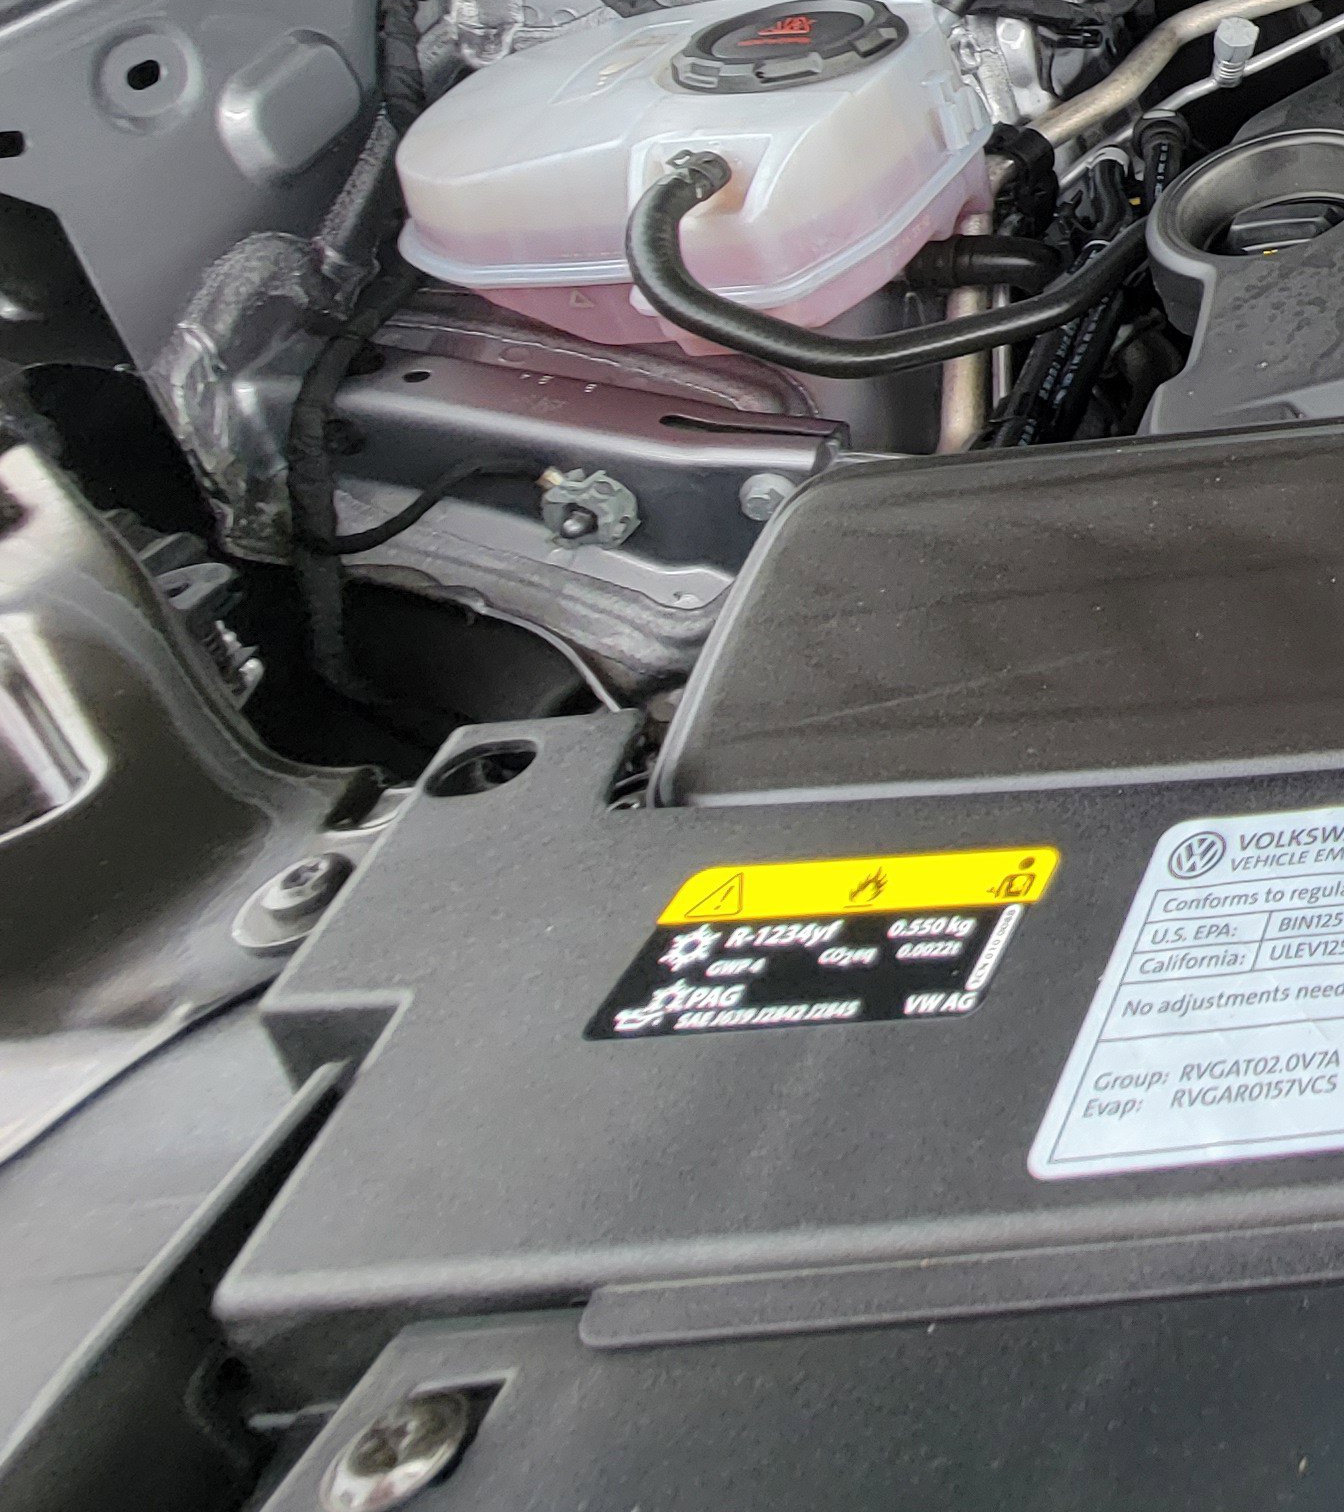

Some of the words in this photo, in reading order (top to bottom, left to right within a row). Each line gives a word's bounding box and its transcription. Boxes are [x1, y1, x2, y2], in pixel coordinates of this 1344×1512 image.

[1230, 850, 1310, 873] VEHICLE
[1163, 892, 1258, 913] Conforms
[1264, 887, 1285, 903] to
[723, 918, 845, 949] R-1234yf
[886, 916, 946, 938] 0.550
[946, 915, 978, 938] kg
[1151, 925, 1186, 946] U.S.
[1194, 921, 1238, 940] EPA:
[1278, 912, 1343, 932] BIN125
[1139, 949, 1246, 976] California:
[684, 984, 747, 1009] PAG
[903, 992, 947, 1015] VW
[941, 990, 980, 1013] AG
[1120, 999, 1152, 1019] No
[1156, 982, 1290, 1018] adjustments
[1092, 1071, 1169, 1093] Group:
[1179, 1048, 1341, 1083] RVGAT02.0V7A
[1081, 1096, 1144, 1122] Evap:
